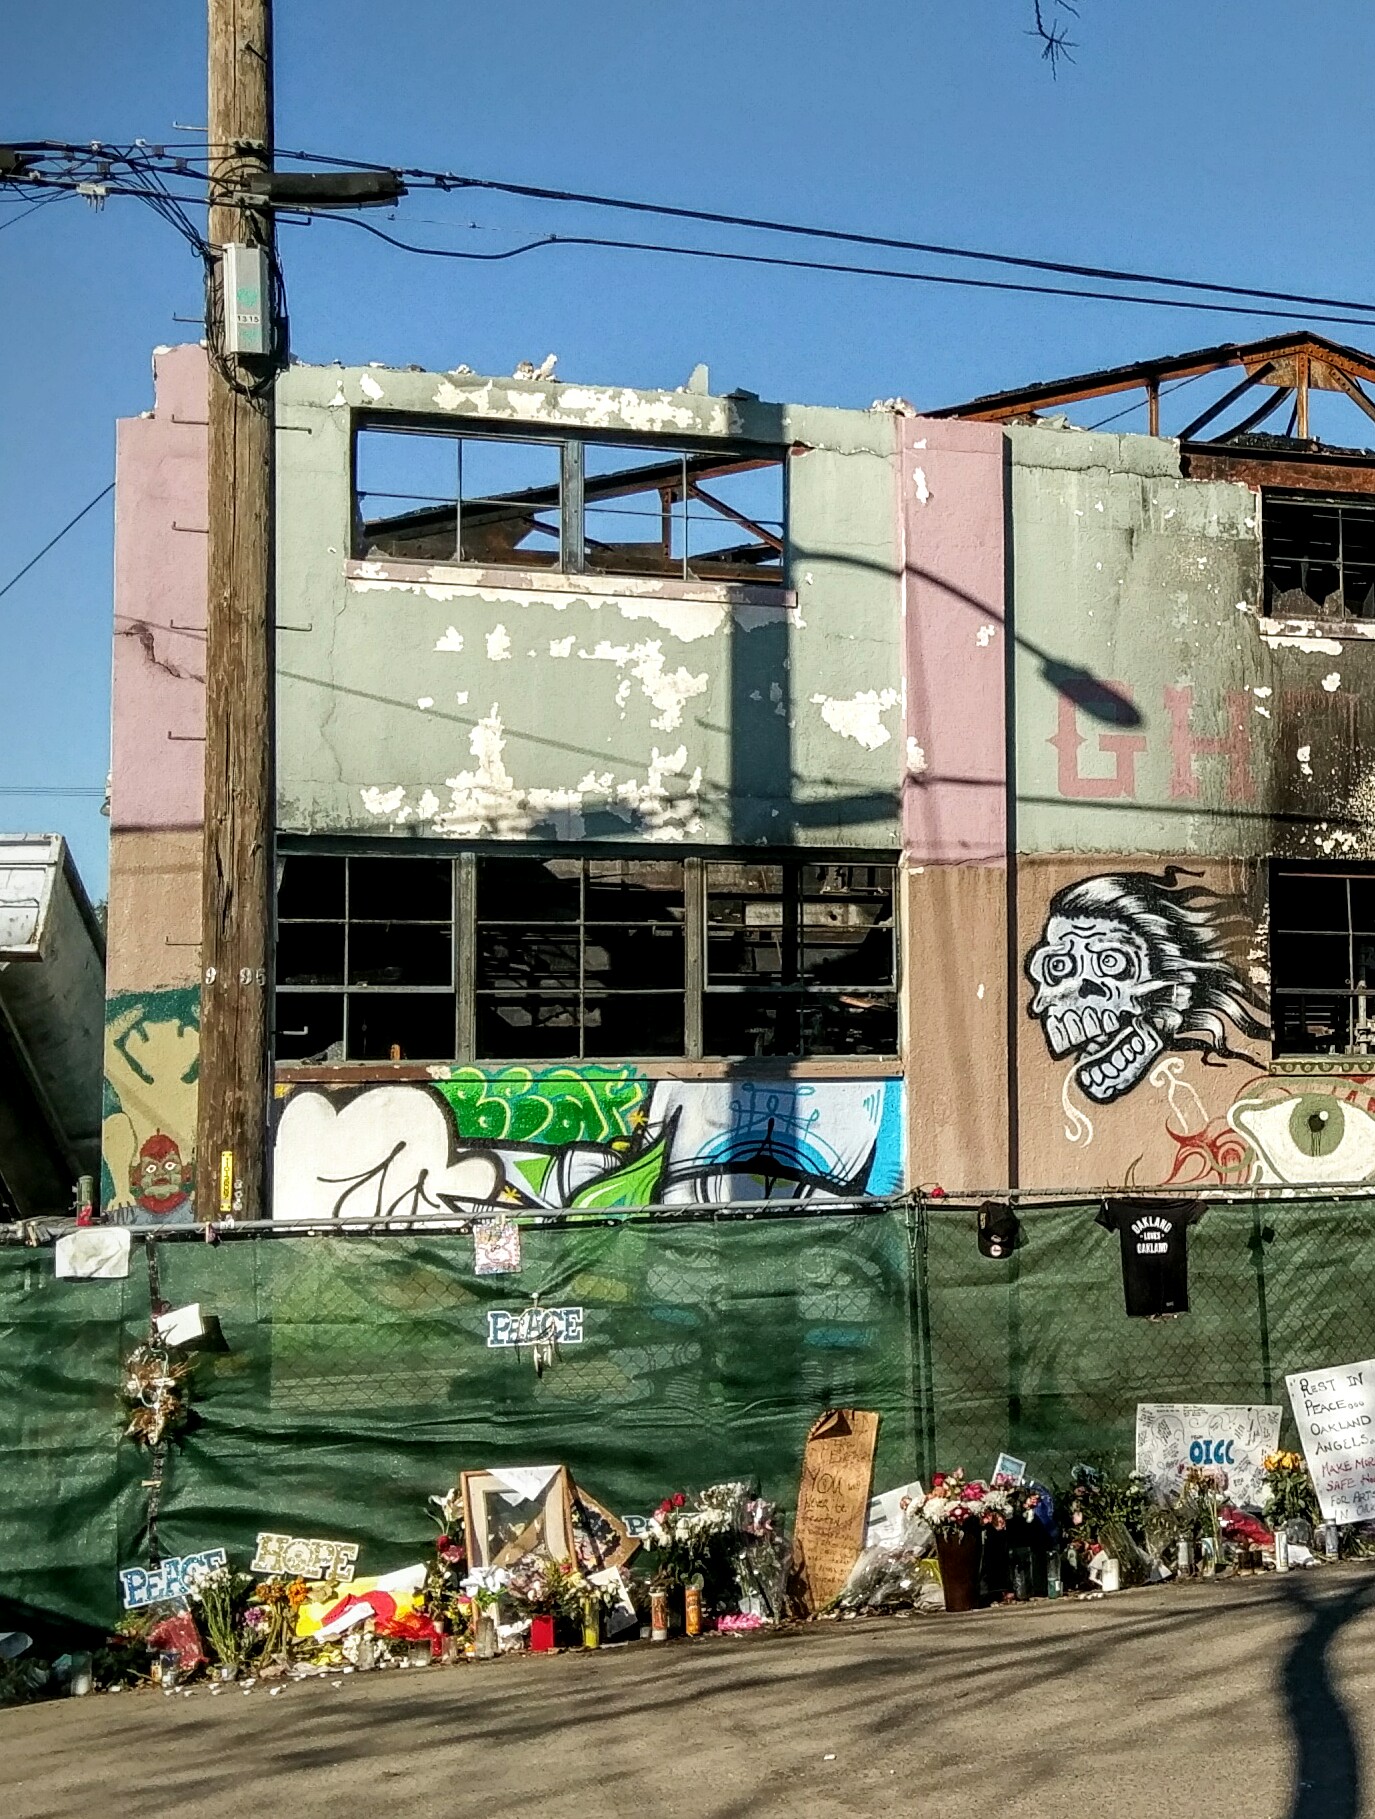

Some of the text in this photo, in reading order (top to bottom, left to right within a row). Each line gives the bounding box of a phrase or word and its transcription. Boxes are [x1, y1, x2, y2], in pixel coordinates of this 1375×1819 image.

[1131, 1216, 1173, 1235] OAKLAND
[1136, 1242, 1169, 1254] OAKLAND
[487, 1307, 583, 1347] PEACE
[1300, 1372, 1363, 1399] REST IN
[1310, 1415, 1372, 1436] OAKLAND
[1321, 1461, 1352, 1478] MAKE
[1326, 1477, 1356, 1492] SAFE
[1331, 1494, 1350, 1507] FOR
[250, 1532, 360, 1583] HOPE
